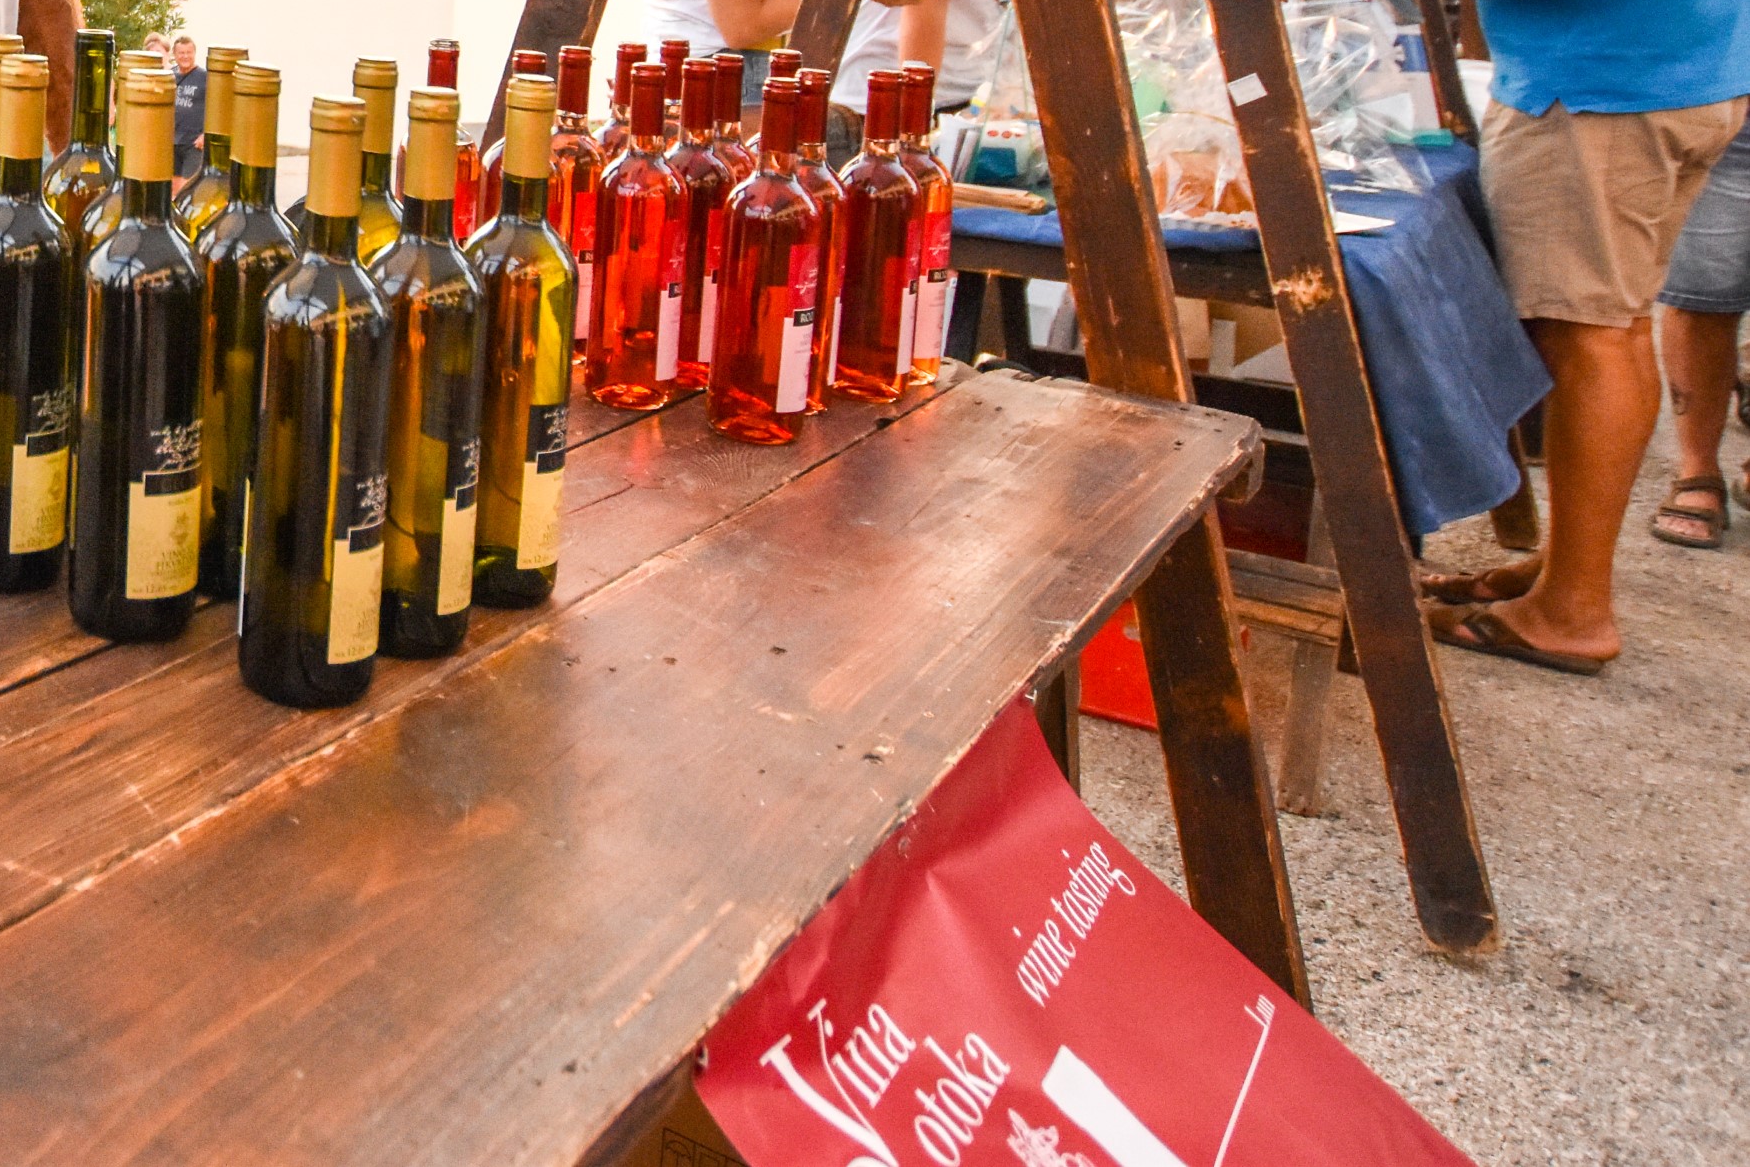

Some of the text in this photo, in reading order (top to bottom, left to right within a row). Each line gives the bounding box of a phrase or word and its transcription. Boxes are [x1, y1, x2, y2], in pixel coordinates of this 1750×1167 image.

[1012, 841, 1137, 1009] wine tasting
[759, 997, 918, 1167] Vina
